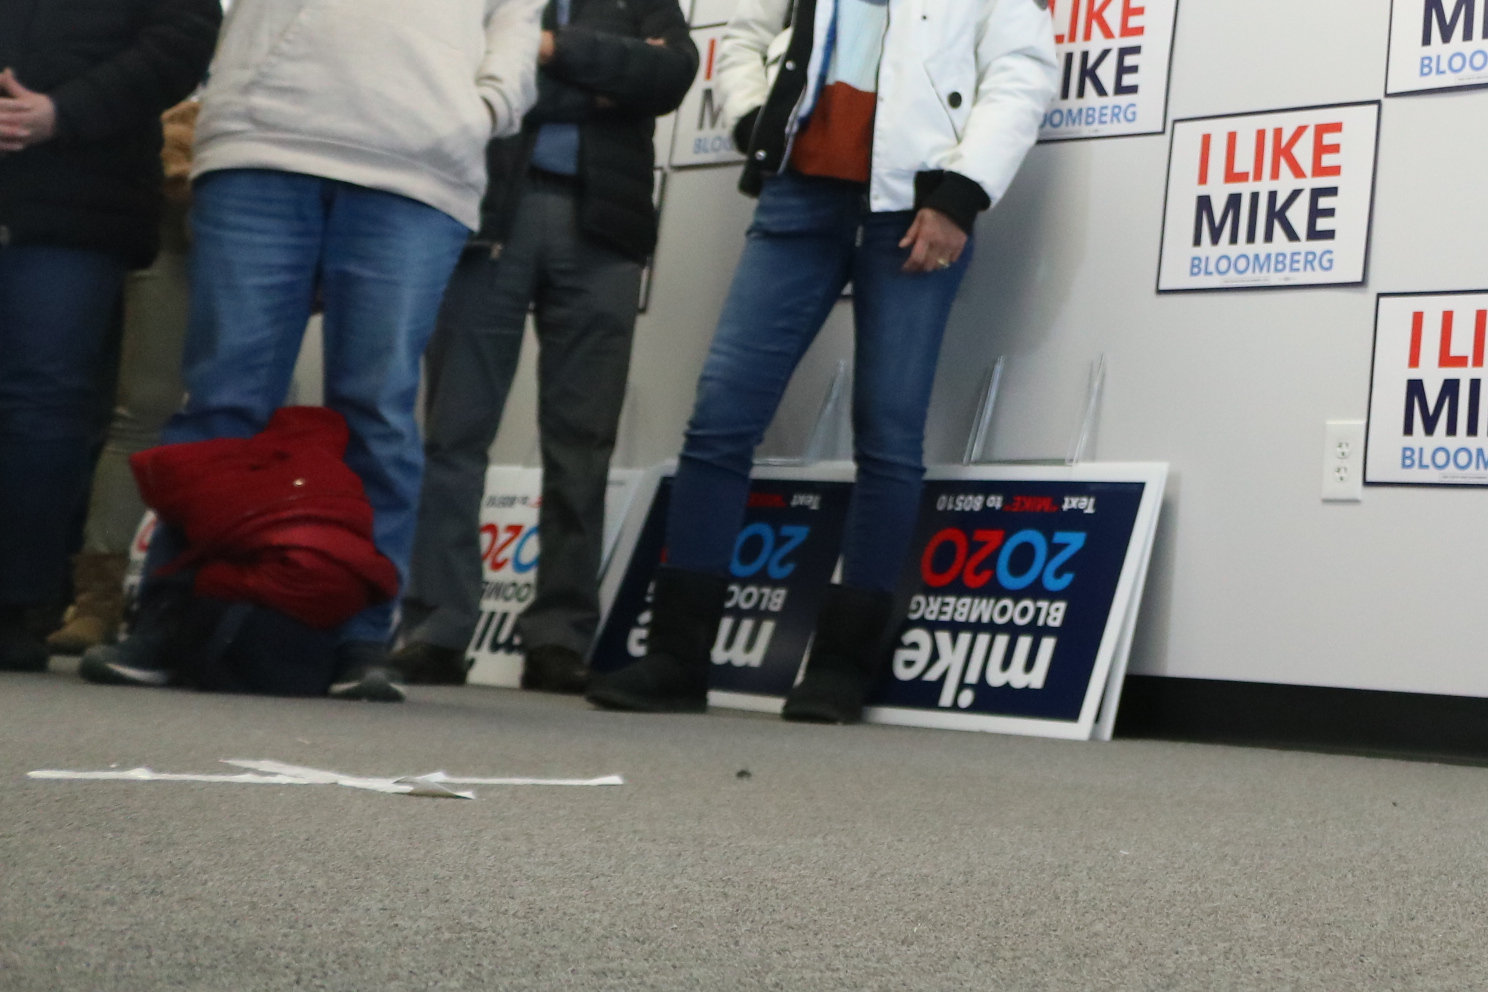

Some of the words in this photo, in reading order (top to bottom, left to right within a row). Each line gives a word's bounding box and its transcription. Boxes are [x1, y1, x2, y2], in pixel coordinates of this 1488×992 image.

[703, 38, 716, 82] I
[1059, 45, 1142, 102] IKE
[1197, 133, 1212, 186] I
[1223, 121, 1344, 185] LIKE
[1192, 186, 1339, 248] MIKE
[1189, 248, 1334, 277] BLOOMBERG
[1407, 310, 1425, 369] I
[936, 494, 985, 512] 80510
[986, 494, 1003, 510] to
[1062, 495, 1095, 514] Text
[729, 522, 811, 580] 20
[921, 526, 1087, 592] 2020
[907, 594, 1068, 628] BLOOMBERG
[892, 627, 1058, 709] mike
